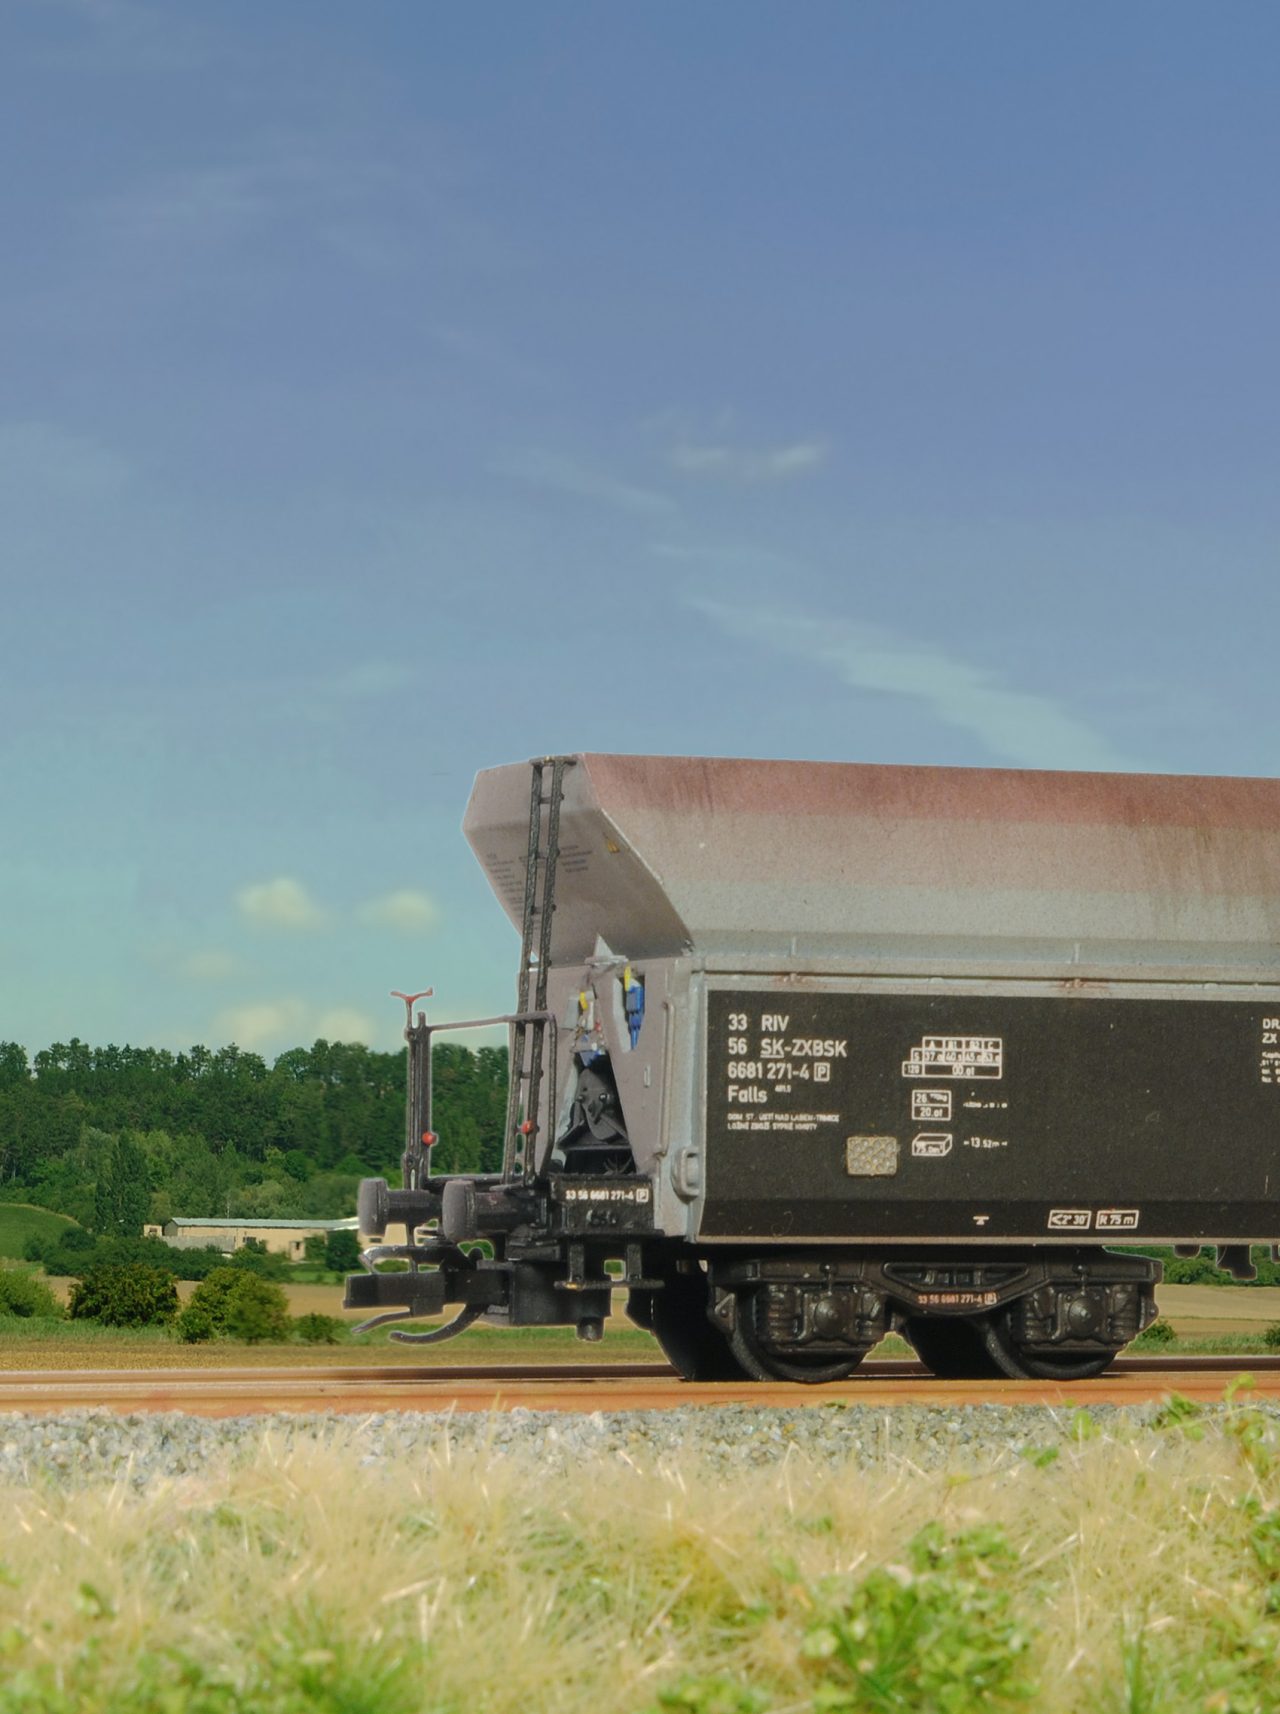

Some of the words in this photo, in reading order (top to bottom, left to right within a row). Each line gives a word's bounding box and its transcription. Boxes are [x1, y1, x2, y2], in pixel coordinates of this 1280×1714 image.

[728, 1013, 748, 1031] 33
[761, 1014, 790, 1032] RIV
[728, 1037, 748, 1055] 56
[760, 1038, 848, 1058] SK-ZXBSK
[1261, 1032, 1278, 1044] ZX
[727, 1061, 763, 1079] 6681
[766, 1062, 810, 1080] 271-4
[728, 1084, 768, 1103] Falls
